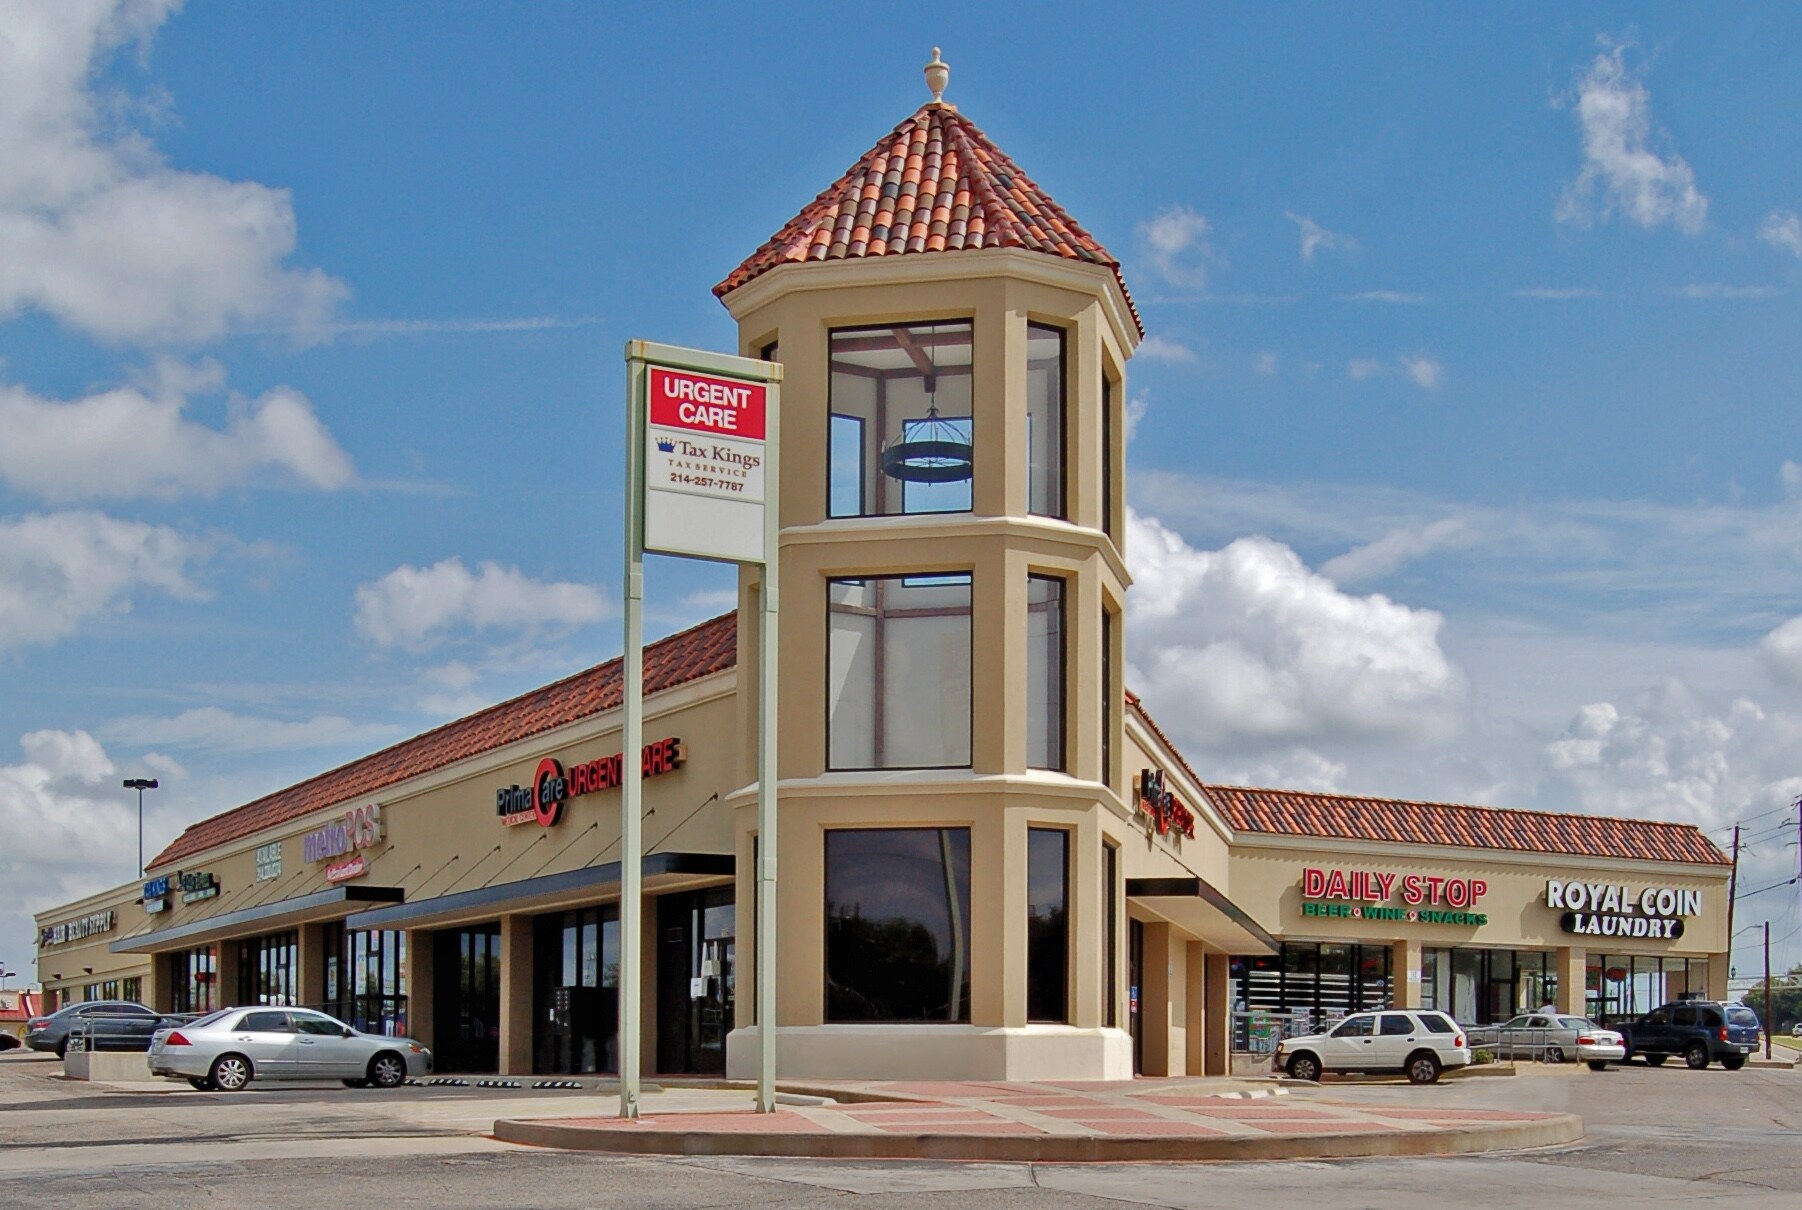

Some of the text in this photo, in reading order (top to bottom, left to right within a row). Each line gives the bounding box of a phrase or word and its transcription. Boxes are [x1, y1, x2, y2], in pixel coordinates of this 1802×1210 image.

[664, 377, 751, 408] URGENT
[679, 403, 737, 429] CARE
[668, 458, 747, 478] TAX SERVICE
[679, 440, 760, 470] Tax Kings
[670, 472, 744, 492] 214-257-7787
[641, 737, 678, 780] ARE
[1303, 868, 1488, 908] DAILY STOP
[1546, 879, 1702, 916] ROYAL COIN
[1303, 903, 1488, 926] BEER WINE SNACKS
[1574, 913, 1677, 938] LAUNDRY
